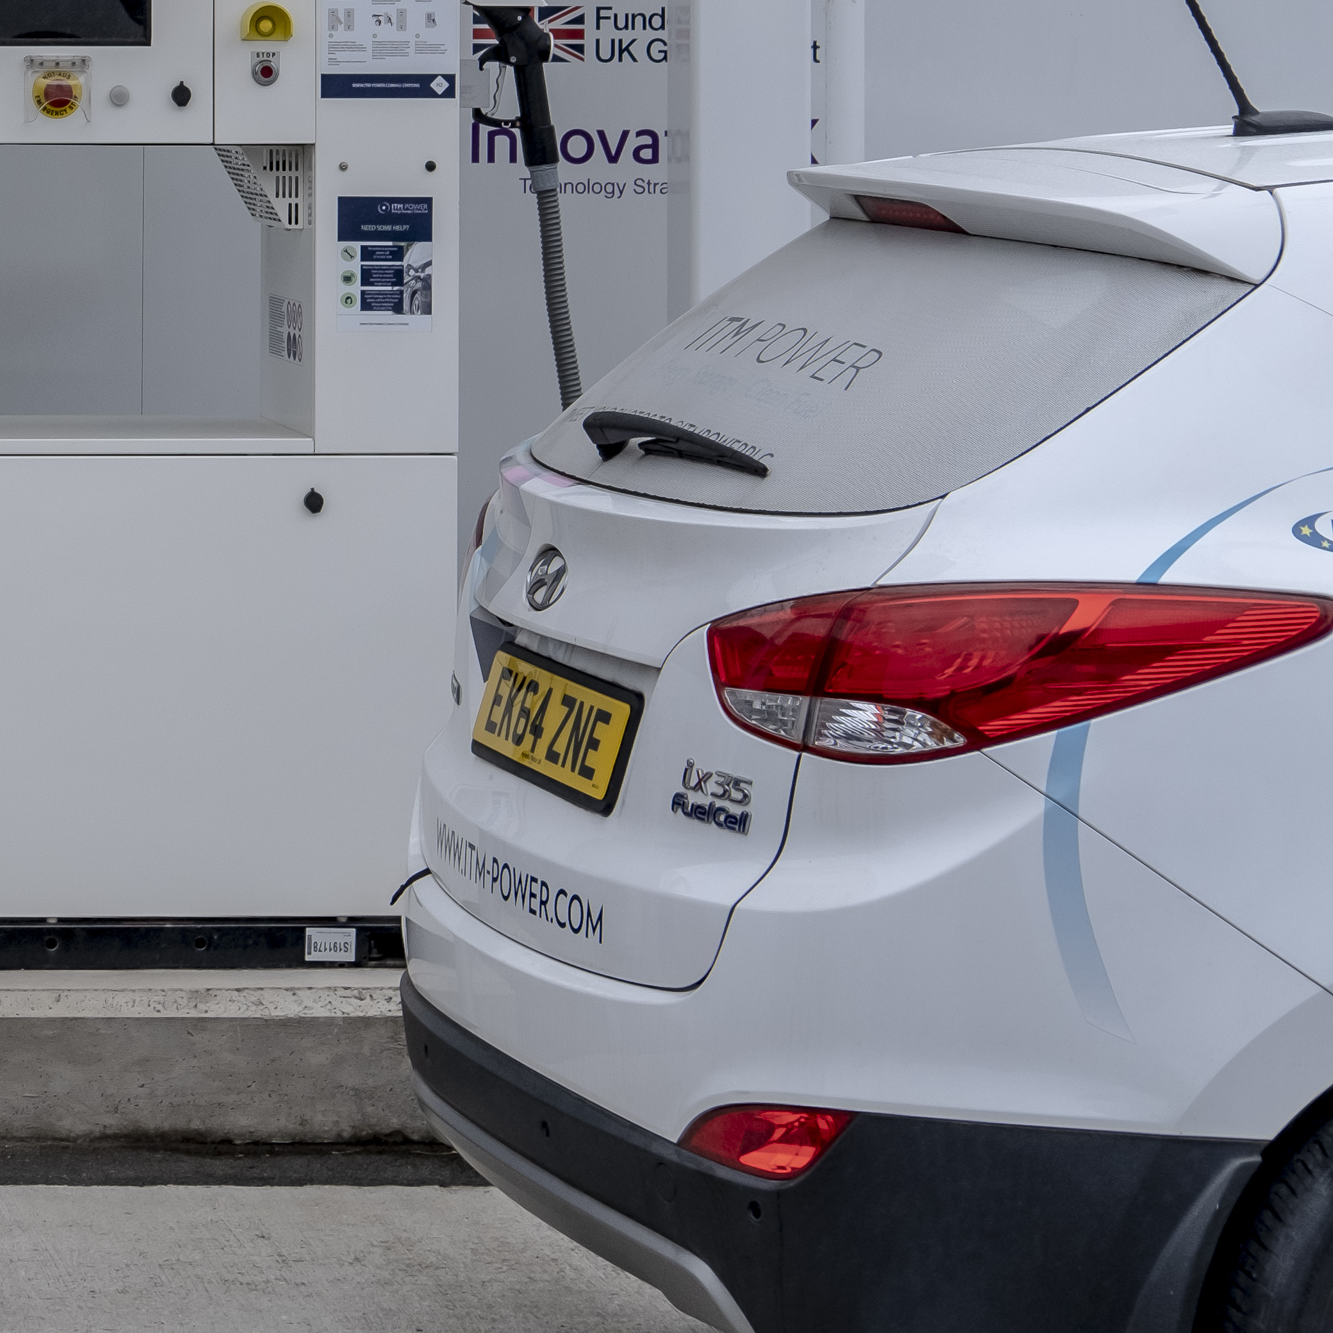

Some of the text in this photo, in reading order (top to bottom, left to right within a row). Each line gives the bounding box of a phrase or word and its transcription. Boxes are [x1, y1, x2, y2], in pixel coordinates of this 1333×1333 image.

[595, 6, 667, 32] Fund
[595, 39, 639, 64] UK
[633, 177, 668, 195] Stra
[684, 316, 883, 391] ITM POWER
[484, 666, 613, 781] EK64 ZNE
[682, 757, 753, 806] ix35
[436, 817, 605, 944] WWW.ITM-POWER.COM
[313, 941, 349, 953] S191178
